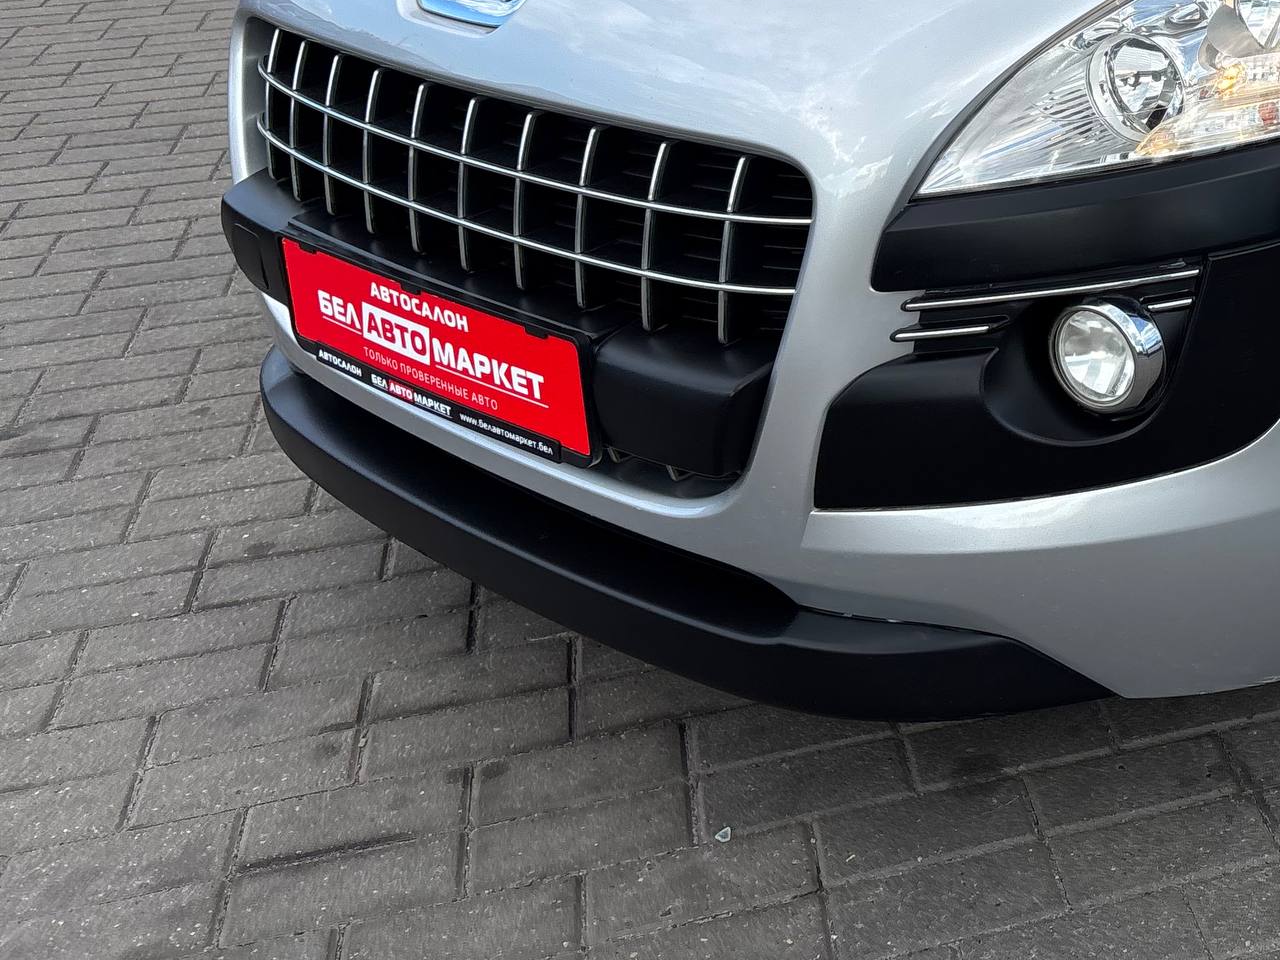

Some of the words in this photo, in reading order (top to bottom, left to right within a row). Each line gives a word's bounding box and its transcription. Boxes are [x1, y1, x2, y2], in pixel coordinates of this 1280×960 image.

[317, 289, 361, 330] БЕЛ
[366, 310, 428, 356] АВТО
[431, 337, 545, 400] МАРКЕТ
[369, 281, 470, 333] АВТОСАЛОН
[318, 349, 363, 377] АВТОСАЛОН
[371, 373, 388, 390] БЕЛ
[389, 381, 413, 400] АВТО
[413, 392, 451, 416] МАРКЕТ
[460, 413, 554, 456] www.белавтомаркет.бел
[363, 346, 398, 370] ТОЛЬКО
[399, 362, 469, 400] ПРОВЕРЕННЫЕ
[471, 392, 498, 411] АВТО
